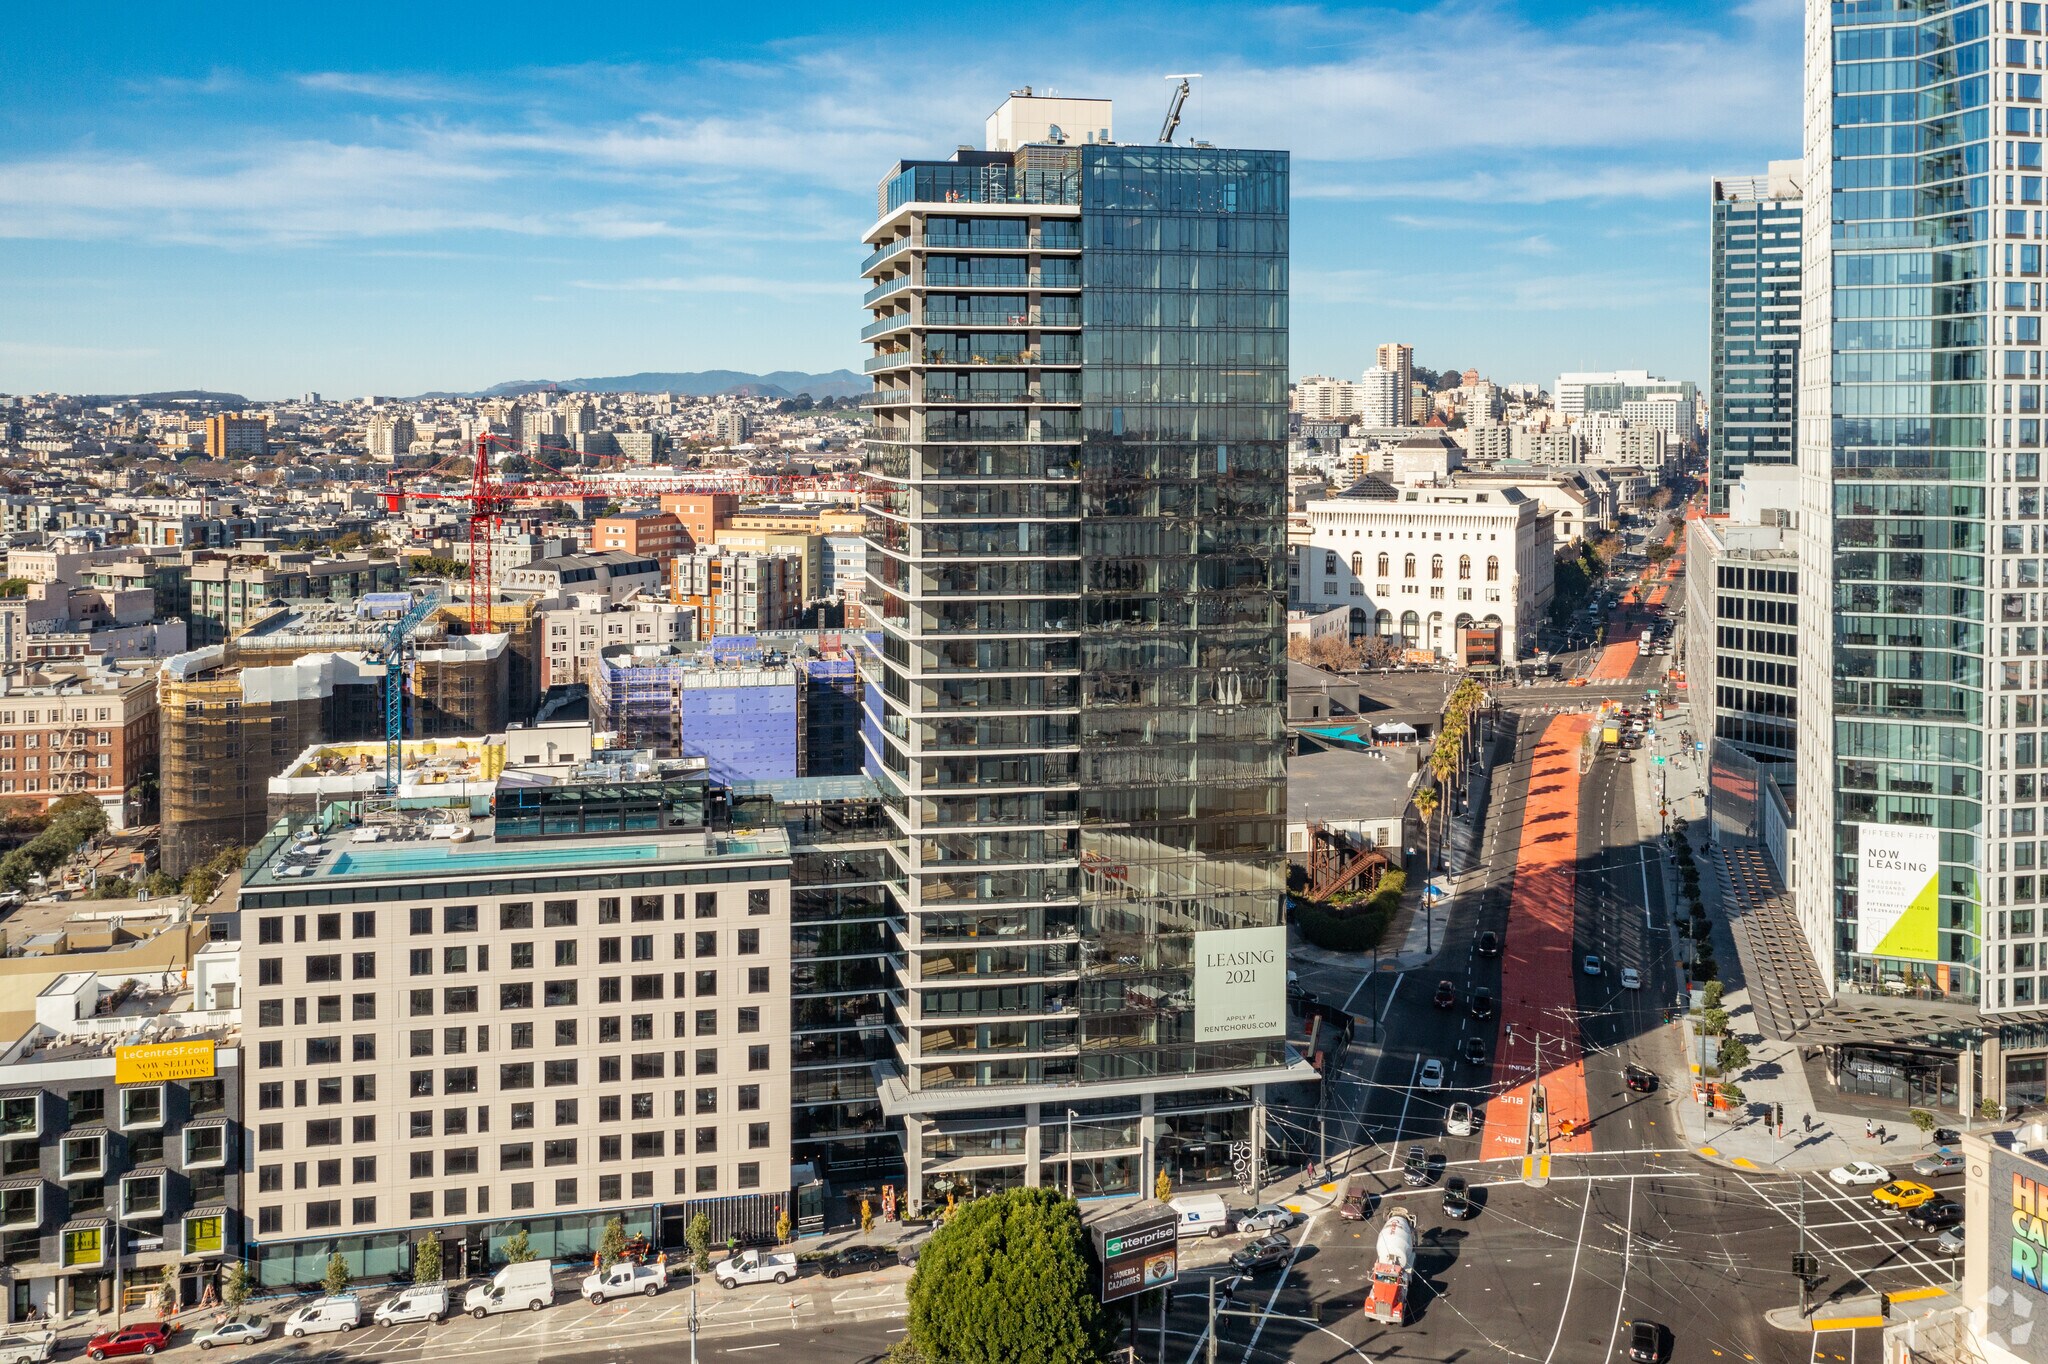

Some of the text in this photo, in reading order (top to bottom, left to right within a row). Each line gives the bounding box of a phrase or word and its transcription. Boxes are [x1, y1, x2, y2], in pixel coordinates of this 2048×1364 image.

[1862, 829, 1936, 840] FIFTEEN FIFTY
[1868, 848, 1900, 859] NOW
[1868, 859, 1927, 872] LEASING
[1207, 950, 1275, 968] LEASING
[1225, 969, 1256, 985] 2021
[1204, 1021, 1277, 1033] RENTCHORUS.COM
[123, 1046, 209, 1060] LeCentreSF.com
[136, 1058, 209, 1070] NOW SELLING
[1850, 1062, 1899, 1075] WE'RE READY.
[142, 1067, 209, 1079] NEW HOMES!
[1856, 1073, 1892, 1084] ARE YOU?
[1501, 1095, 1524, 1105] BUS
[1495, 1135, 1521, 1145] ONLY
[2011, 1209, 2048, 1250] CA
[1109, 1228, 1174, 1252] enterprise
[1113, 1267, 1136, 1279] TAQUERIA
[1108, 1273, 1141, 1291] CAZADORES
